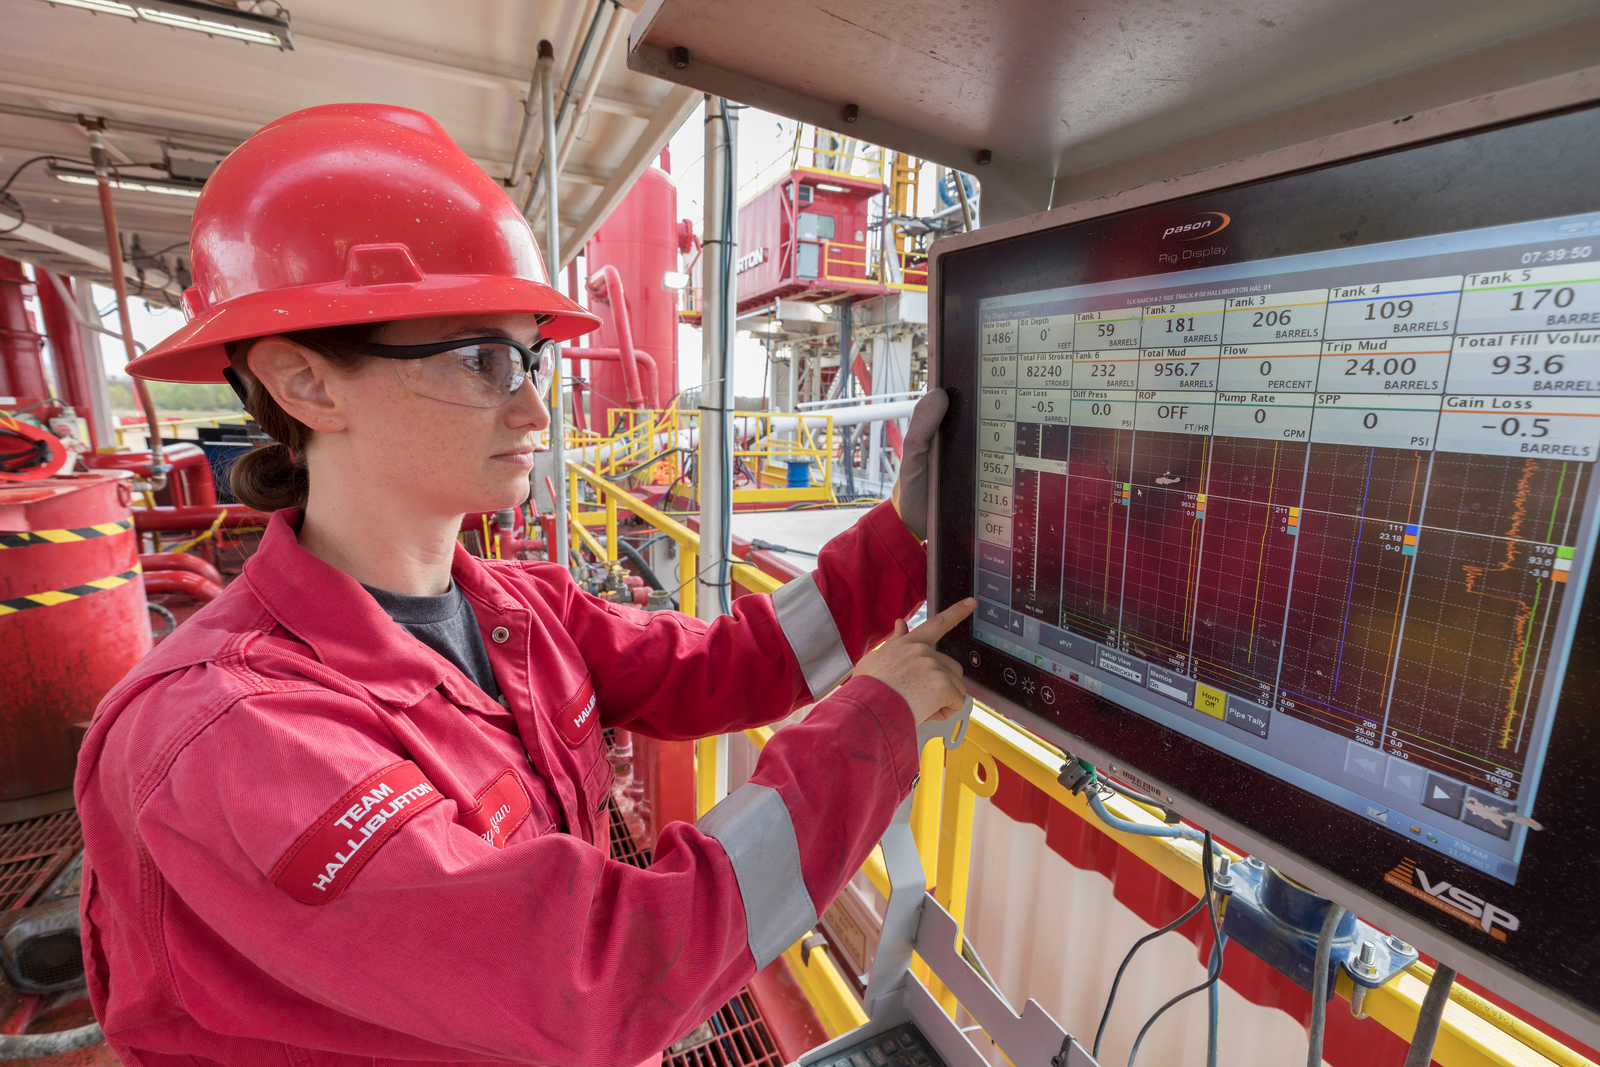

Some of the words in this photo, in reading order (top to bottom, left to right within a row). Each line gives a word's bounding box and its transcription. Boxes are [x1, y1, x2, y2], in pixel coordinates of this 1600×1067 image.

[1162, 220, 1212, 240] pason
[1158, 253, 1178, 264] Rig
[1182, 246, 1228, 260] Display
[1521, 246, 1592, 264] 07:39:50
[1469, 272, 1513, 286] Tank
[1521, 270, 1532, 281] 5
[1207, 287, 1249, 297] HALLIBURTON
[1333, 286, 1366, 298] Tank
[1371, 284, 1381, 295] 4
[1228, 297, 1254, 308] Tank
[1260, 296, 1266, 305] 3
[1510, 287, 1576, 311] 170
[1145, 306, 1166, 315] Tank
[1170, 305, 1175, 313] 2
[1364, 300, 1414, 321] 109
[1030, 318, 1049, 326] Depth
[1077, 313, 1095, 321] Tank
[1252, 310, 1292, 327] 206
[1098, 323, 1115, 337] 59
[1165, 317, 1195, 333] 181
[1393, 321, 1449, 333] BARRELS
[1184, 334, 1218, 343] BARRELS
[1275, 329, 1318, 339] BARRELS
[1109, 338, 1137, 346] BARRELS
[1325, 342, 1352, 353] Trip
[1358, 340, 1388, 351] Mud
[1458, 335, 1503, 348] Total
[1510, 334, 1538, 346] Fill
[1142, 349, 1164, 358] Total
[1167, 348, 1186, 357] Mud
[1223, 346, 1248, 356] Flow
[1091, 364, 1116, 377] 232
[1154, 362, 1200, 377] 956.7
[1259, 360, 1272, 376] 0
[1344, 358, 1417, 376] 24.00
[1491, 354, 1565, 375] 93.6
[991, 366, 1006, 377] 0.0
[1027, 365, 1062, 377] 82240
[1268, 380, 1313, 389] PERCENT
[1384, 380, 1438, 390] BARRELS
[1138, 392, 1156, 400] ROP
[1218, 393, 1246, 404] Pump
[1251, 393, 1275, 403] Rate
[1318, 395, 1341, 404] SPP
[995, 399, 1000, 410] 0
[1447, 397, 1484, 408] Gain
[1492, 398, 1533, 409] Loss
[1092, 403, 1111, 416] 0.0
[1157, 405, 1189, 420] OFF
[1254, 408, 1266, 424] 0
[1363, 412, 1378, 429] 0
[1184, 424, 1210, 432] FT/HR
[1283, 429, 1305, 438] GPM
[994, 431, 1000, 442] 0
[1410, 437, 1429, 446] PSI
[1520, 443, 1590, 457] BARRELS
[983, 462, 1009, 475] 956.7
[980, 481, 992, 489] Block
[983, 492, 1008, 506] 211.6
[986, 523, 1003, 535] OFF
[1379, 533, 1402, 542] 23.18
[1535, 546, 1554, 554] 170
[1529, 556, 1551, 566] 93.6
[1101, 650, 1117, 663] Setup
[1118, 657, 1132, 666] View
[1150, 670, 1172, 684] Memos
[1259, 683, 1270, 691] 300
[1202, 691, 1220, 703] Horn
[1281, 699, 1295, 708] 0.00
[1229, 708, 1246, 720] Pipe
[1247, 715, 1266, 728] Tally
[1362, 720, 1377, 730] 200
[1355, 726, 1376, 738] 25.00
[1355, 735, 1374, 746] 5000
[1390, 739, 1403, 748] 0.0
[1494, 767, 1513, 779] 200
[1485, 774, 1511, 788] 100.0
[1494, 787, 1509, 798] 5.0
[333, 782, 394, 830] TEAM
[312, 782, 434, 892] HALLIBURTON
[1453, 840, 1471, 852] 7:39
[1472, 849, 1488, 860] AM
[1387, 876, 1415, 893] VERSATILE
[1416, 890, 1443, 908] SERVICES
[1445, 906, 1475, 924] PLATFORM
[1415, 868, 1520, 934] VSP
